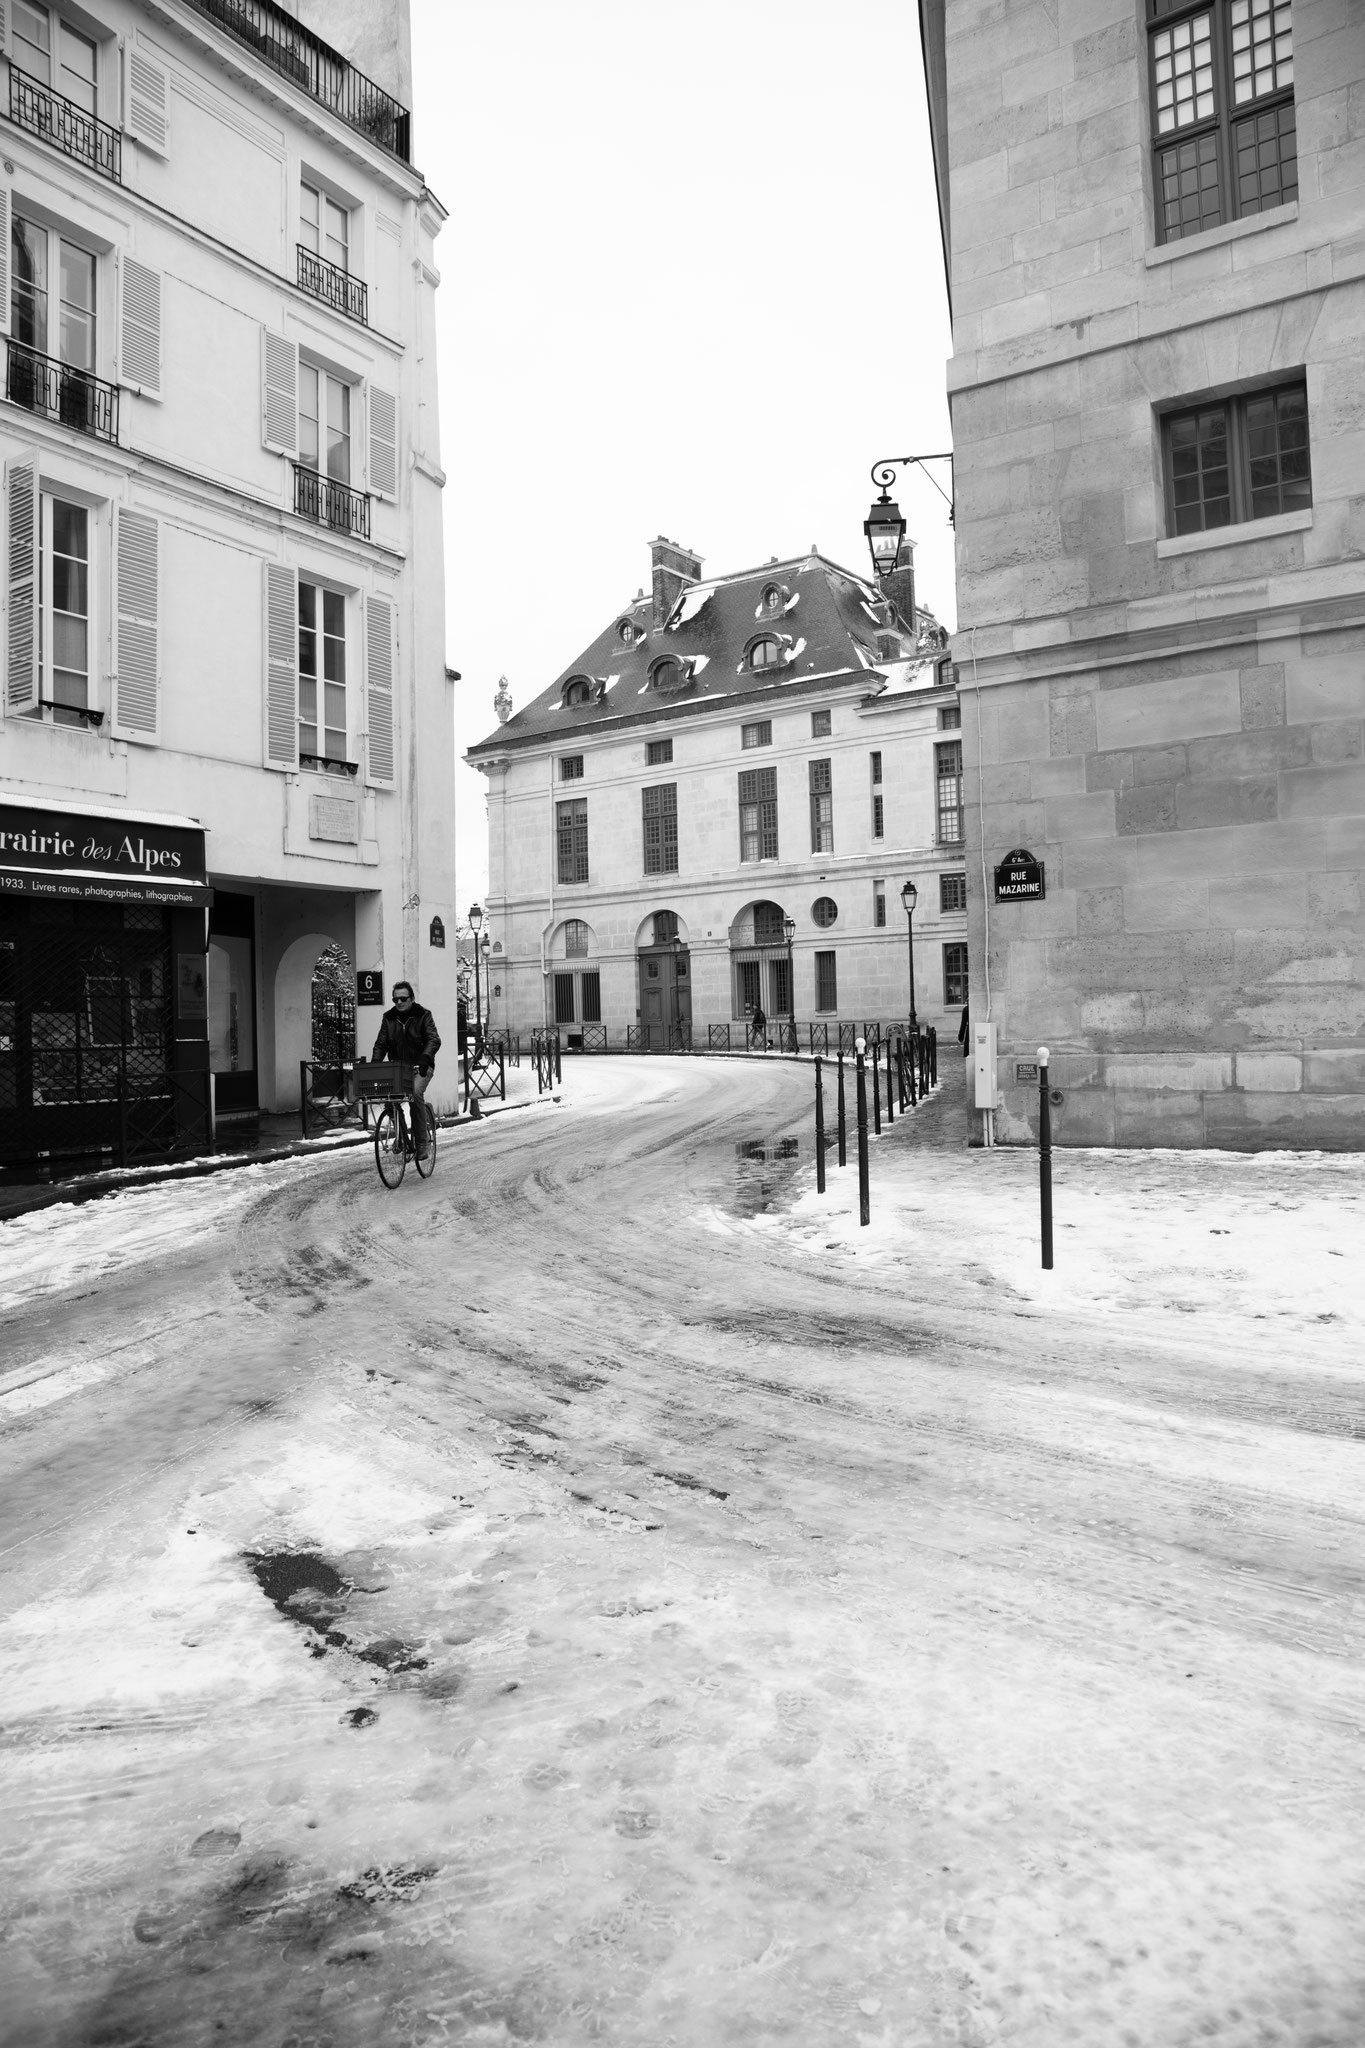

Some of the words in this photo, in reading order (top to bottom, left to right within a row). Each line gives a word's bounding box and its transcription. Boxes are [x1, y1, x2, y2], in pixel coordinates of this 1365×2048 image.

[0, 829, 75, 857] rairie
[82, 837, 113, 860] des
[114, 835, 182, 872] Alpes
[1010, 871, 1027, 881] RUE
[0, 877, 27, 889] 1933.
[32, 880, 57, 892] Livres
[59, 885, 83, 895] rares,
[84, 884, 144, 899] photographies,
[145, 889, 193, 902] lithographies
[998, 882, 1040, 895] MAZARINE
[365, 975, 373, 990] 6
